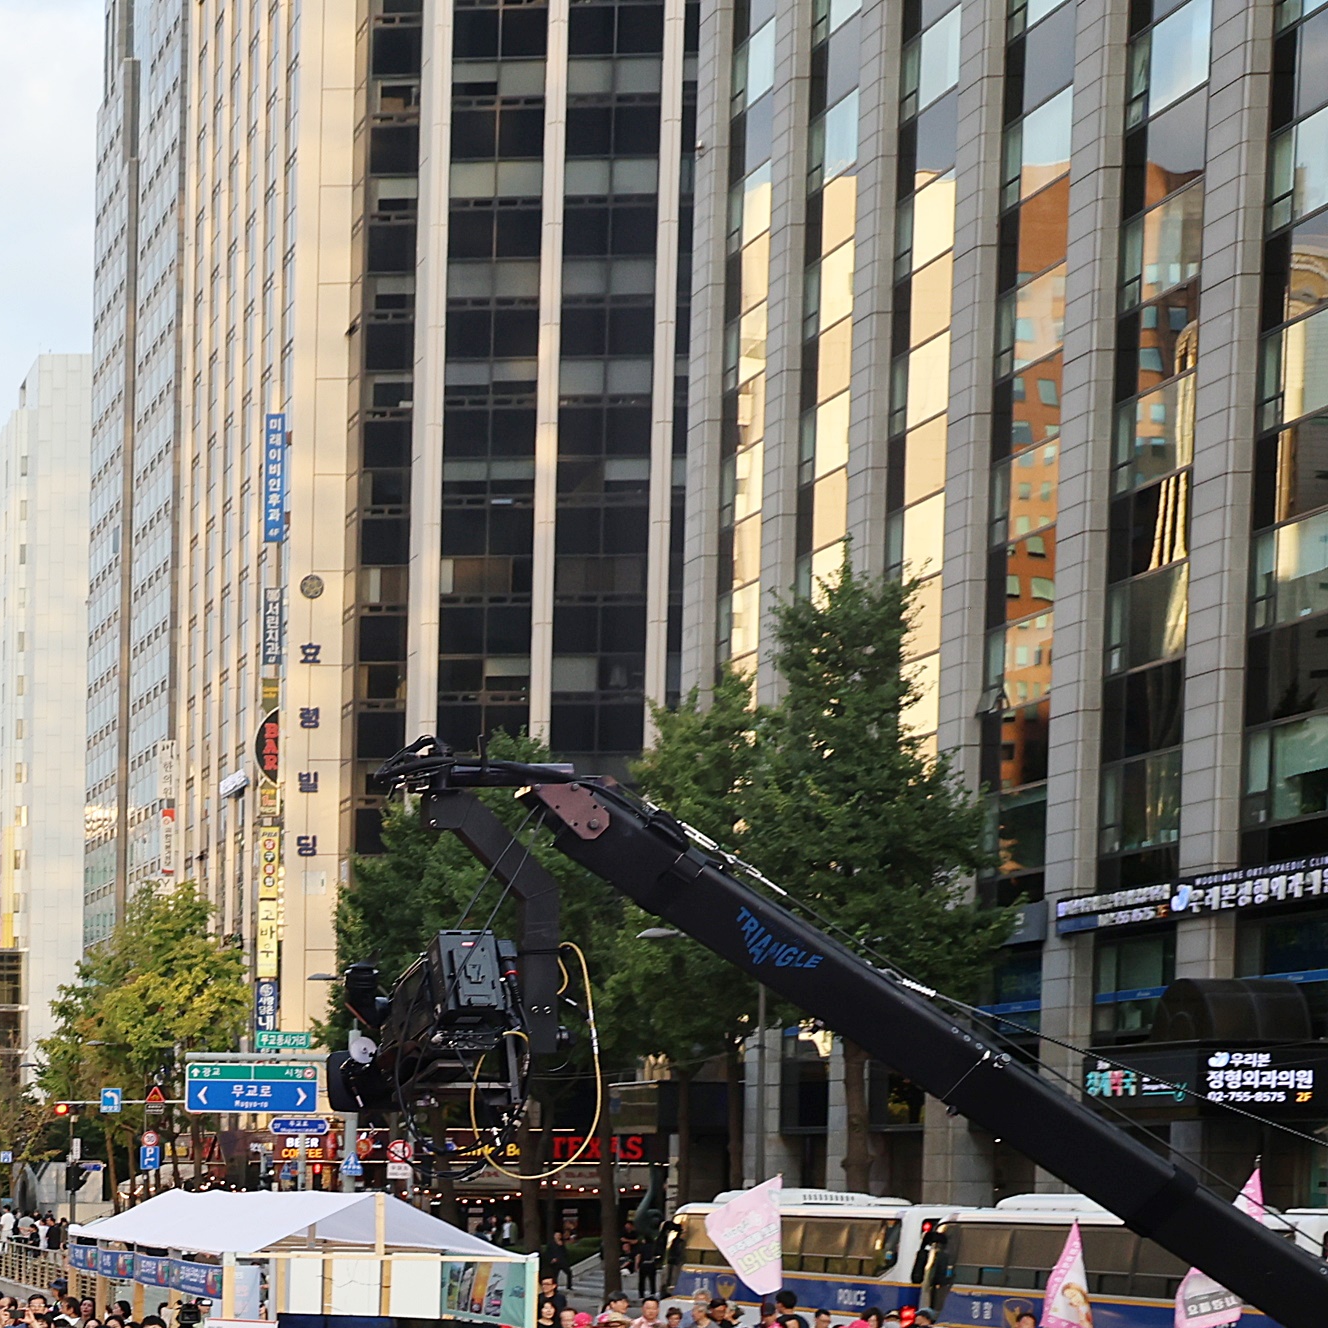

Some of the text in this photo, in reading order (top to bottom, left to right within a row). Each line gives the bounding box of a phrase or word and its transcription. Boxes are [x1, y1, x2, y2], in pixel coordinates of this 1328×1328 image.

[263, 722, 279, 771] BAR
[736, 906, 824, 968] TRIANGLE
[260, 1034, 307, 1046] 무교동사거리
[1230, 1053, 1271, 1067] 우리본
[202, 1067, 304, 1078] 광교 시청
[1206, 1070, 1313, 1090] 정형외과의원
[231, 1085, 272, 1098] 무교로
[1207, 1091, 1312, 1102] 02-755-8575 2F
[285, 1137, 320, 1148] BEER
[837, 1289, 867, 1306] POLICE
